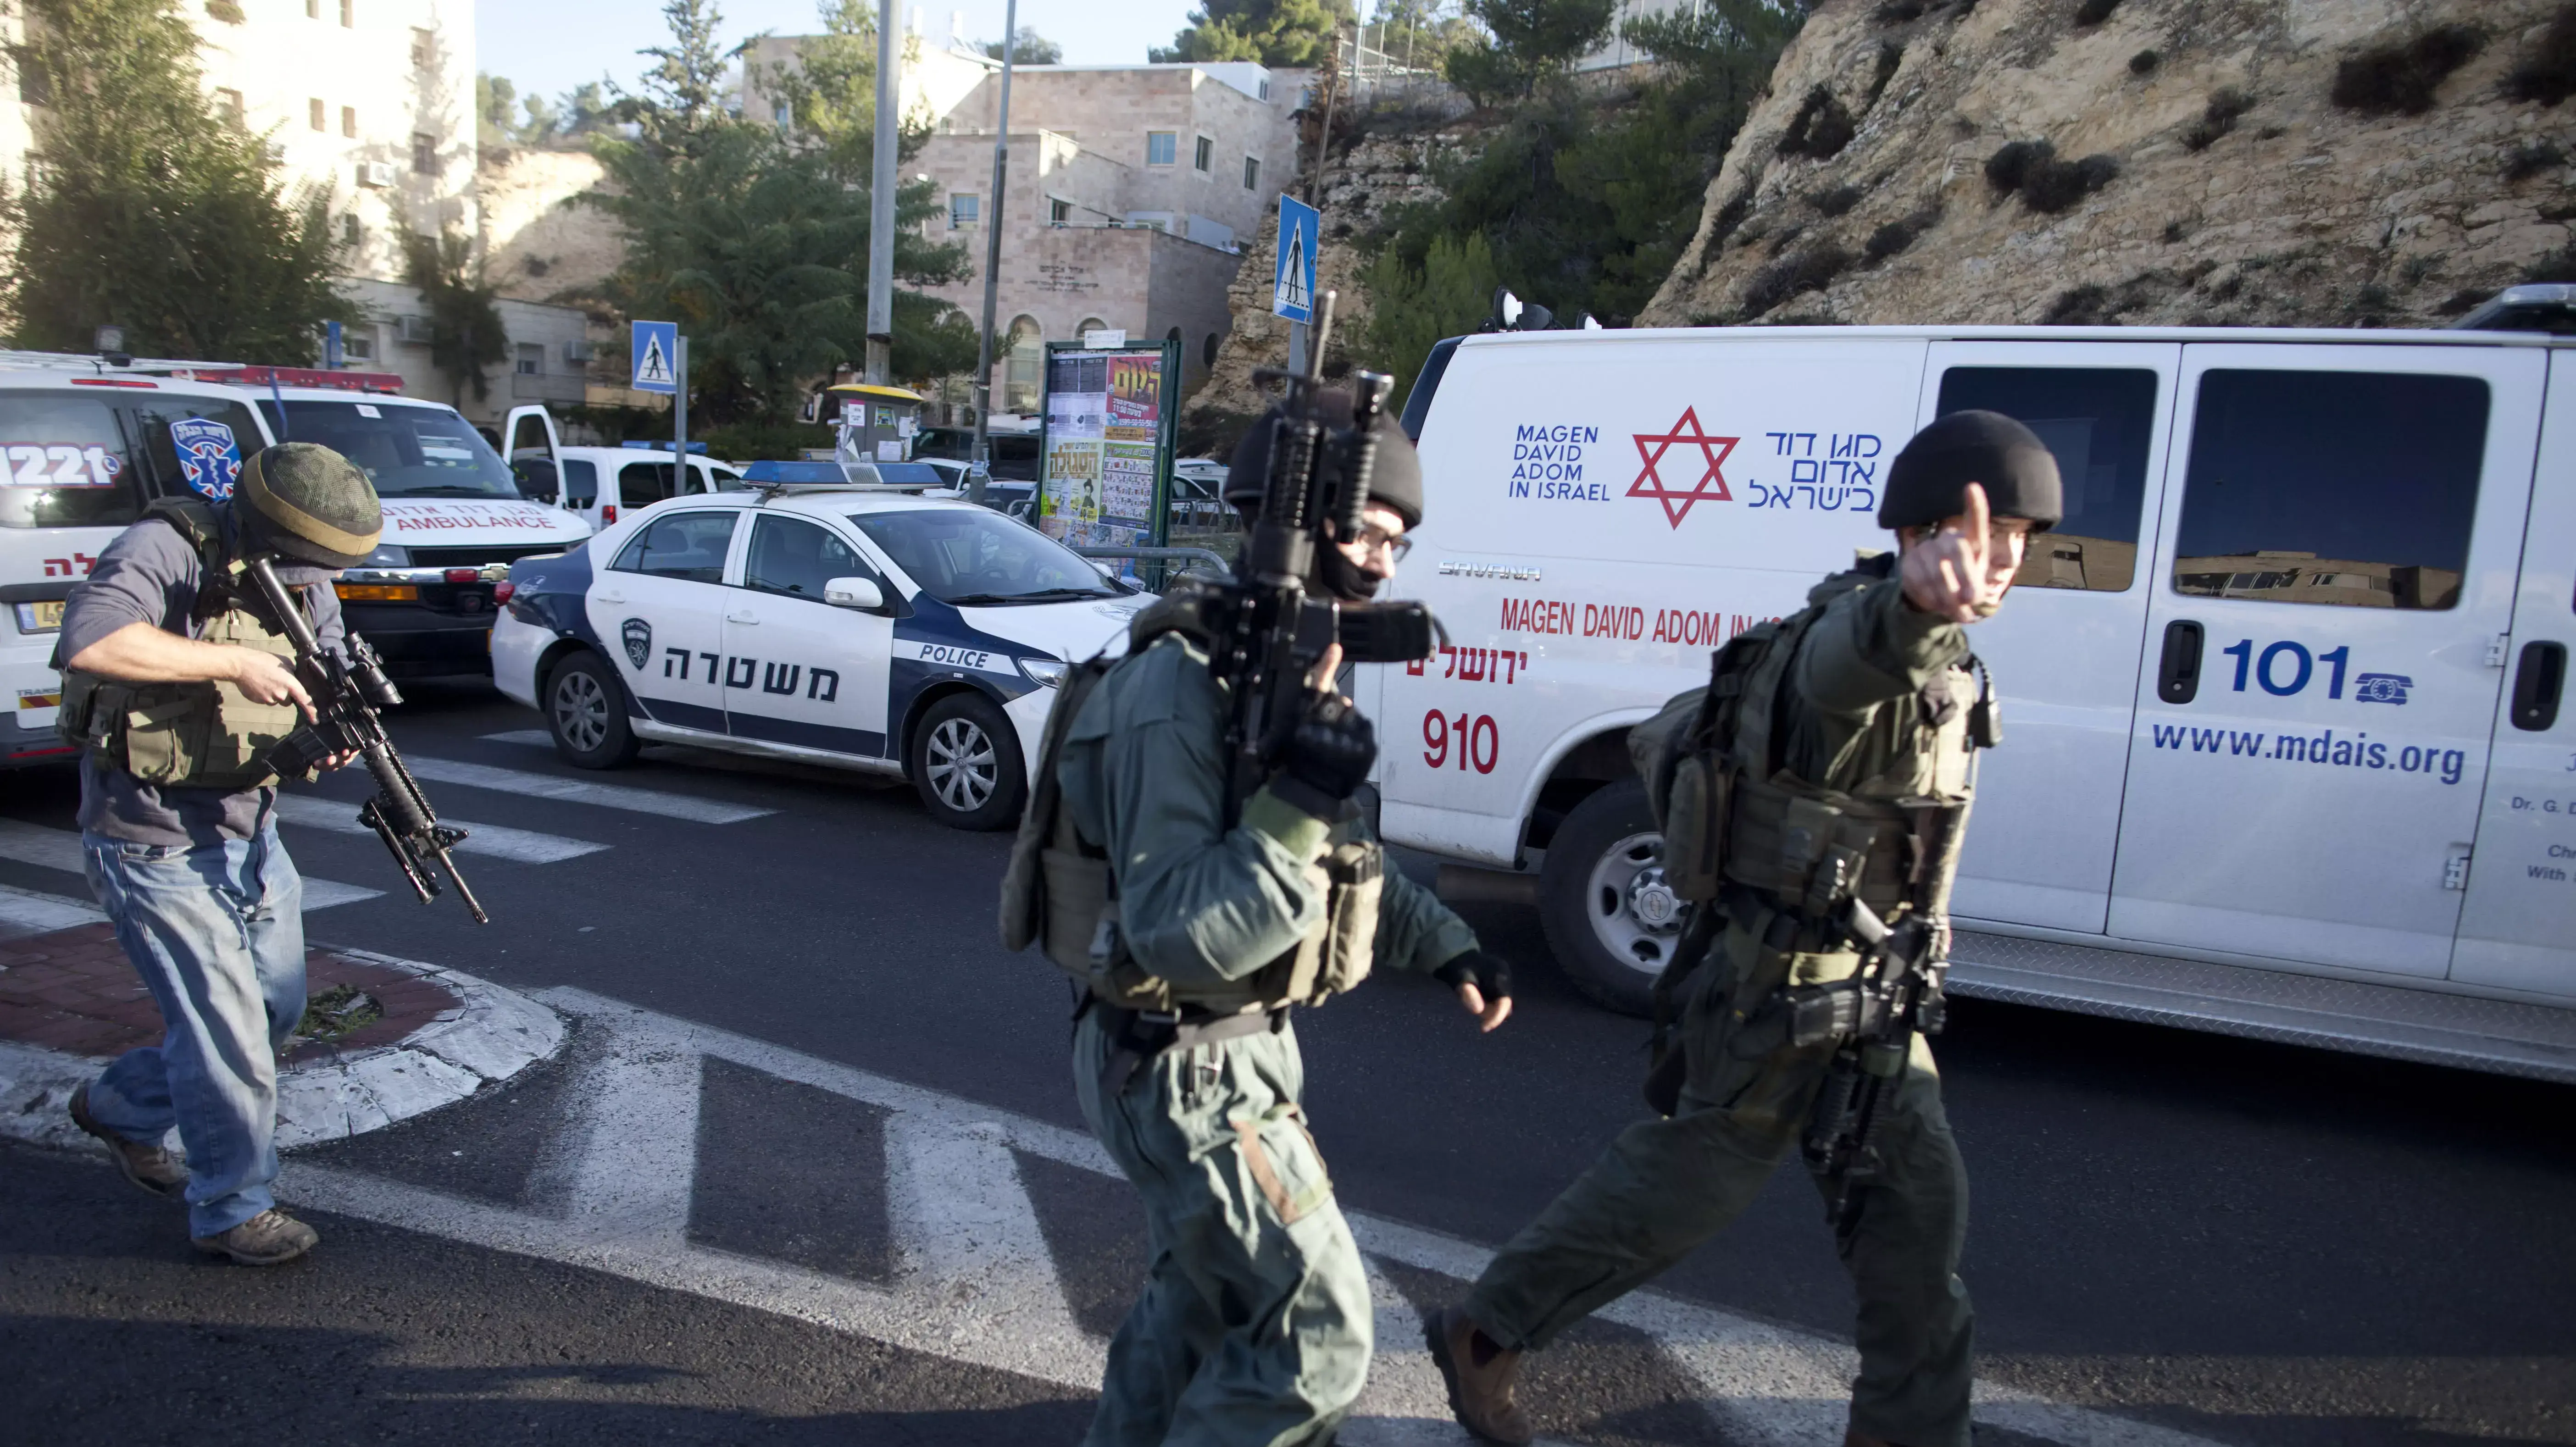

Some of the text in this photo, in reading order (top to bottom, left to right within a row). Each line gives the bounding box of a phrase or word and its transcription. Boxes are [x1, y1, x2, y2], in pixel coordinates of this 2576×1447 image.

[1516, 425, 1599, 443] MAGEN
[1765, 432, 1882, 459] מגן דוד
[1514, 444, 1581, 461] DAVID
[1512, 462, 1582, 481] ADOM
[1791, 460, 1876, 485] אדום
[1509, 481, 1610, 501] IN ISRAEL
[1748, 479, 1874, 511] בישראל
[397, 516, 556, 531] AMBULANCE
[1439, 560, 1542, 582] SAVANA
[1501, 598, 1575, 635] MAGEN
[1583, 604, 1644, 640] DAVID
[1652, 609, 1721, 646] ADOM
[920, 644, 989, 668] POLICE
[664, 647, 839, 703] משטרה
[2223, 639, 2350, 699] 101
[1423, 709, 1499, 775] 910
[2153, 724, 2465, 785] www.mdais.org
[2511, 797, 2535, 811] Dr.
[2527, 865, 2567, 882] With
